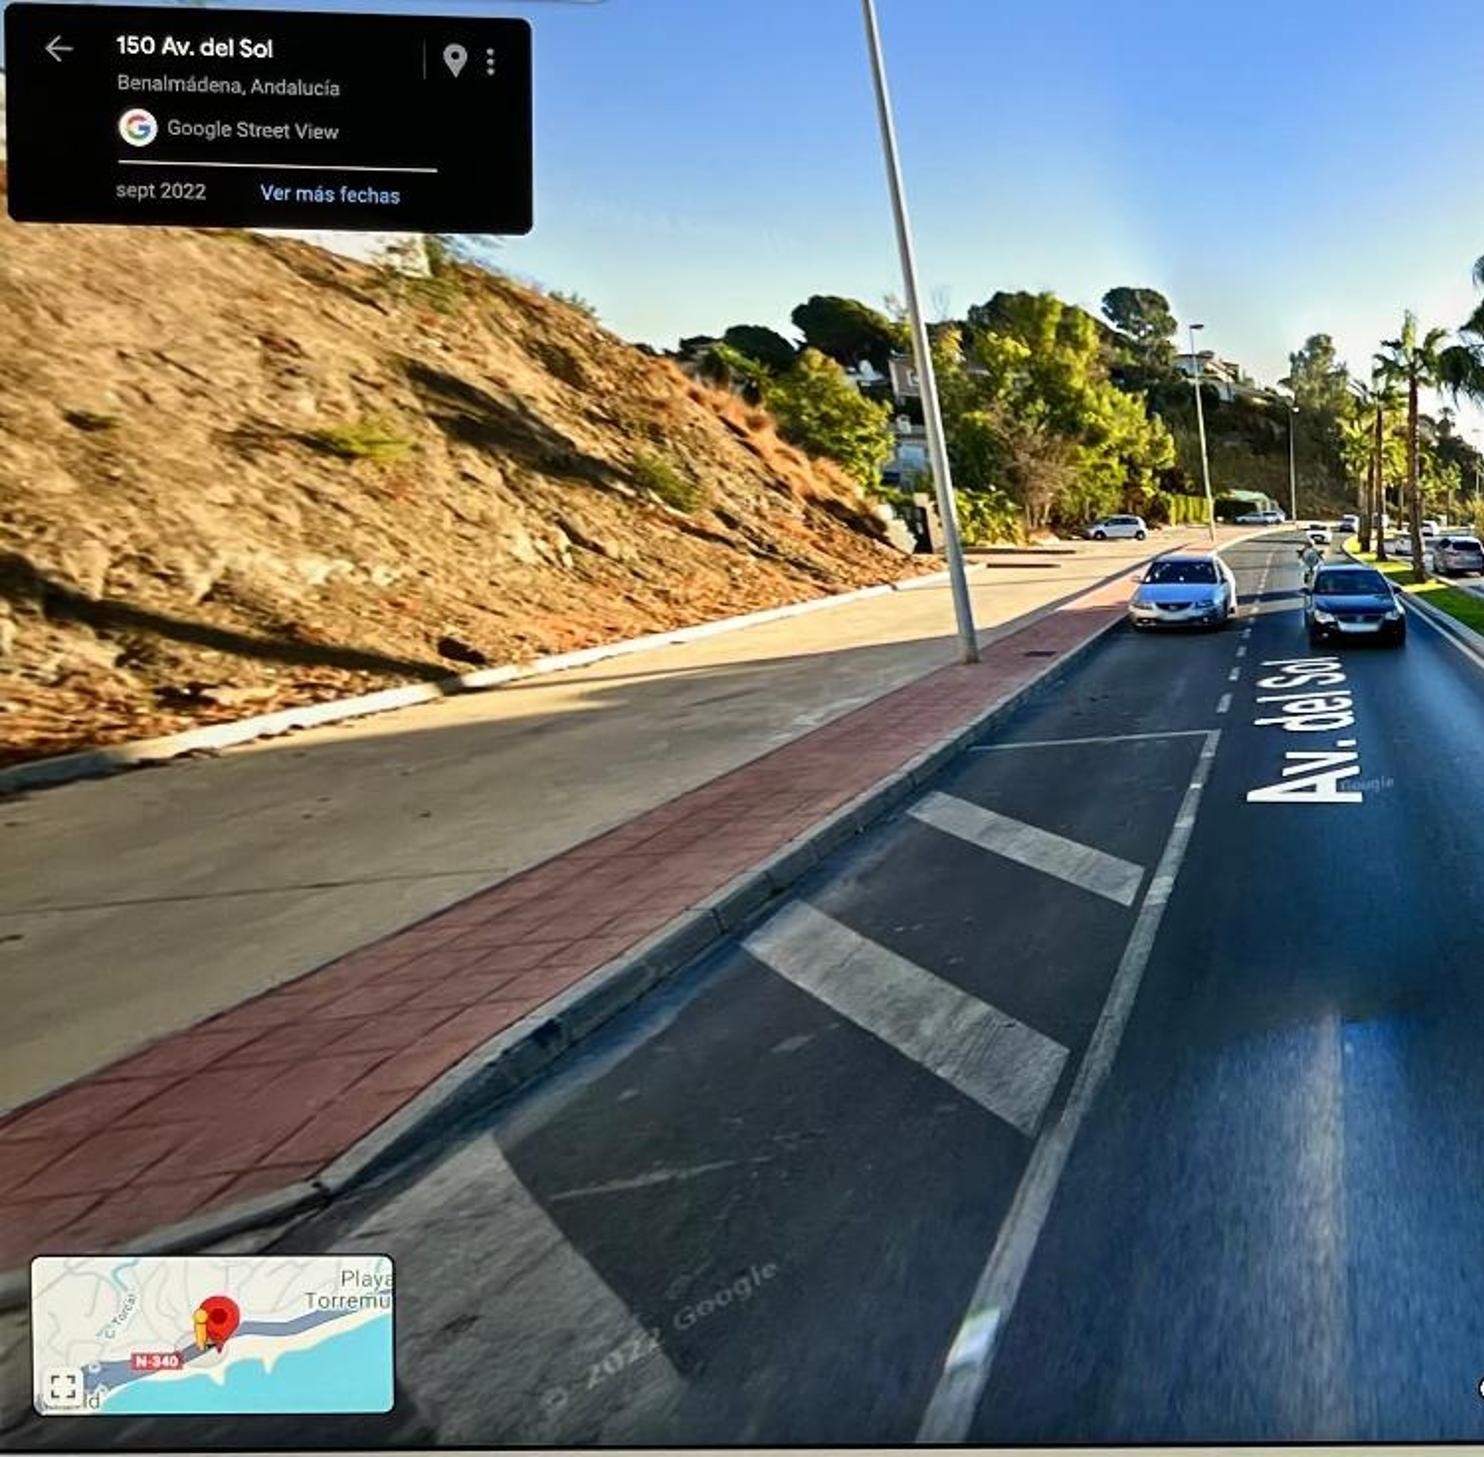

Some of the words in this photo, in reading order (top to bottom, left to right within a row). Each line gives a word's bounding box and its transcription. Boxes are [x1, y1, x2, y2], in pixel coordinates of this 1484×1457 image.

[116, 35, 156, 55] 150
[161, 36, 195, 57] Av.
[200, 37, 235, 58] del
[239, 38, 274, 59] Sol
[117, 73, 247, 96] Benalmádena,
[250, 78, 340, 97] Andalucía
[167, 119, 233, 141] Google
[236, 121, 290, 139] Street
[294, 123, 340, 140] View
[116, 183, 156, 202] sept
[160, 182, 206, 200] 2022
[260, 183, 292, 201] Ver
[295, 185, 336, 203] más
[339, 185, 401, 205] fechas
[1257, 656, 1347, 688] Sol
[1254, 690, 1354, 732] del
[1247, 739, 1362, 802] Av.
[341, 1269, 393, 1293] Playa
[304, 1292, 391, 1310] Torremu
[673, 1262, 780, 1331] Google
[135, 1354, 180, 1368] N-340
